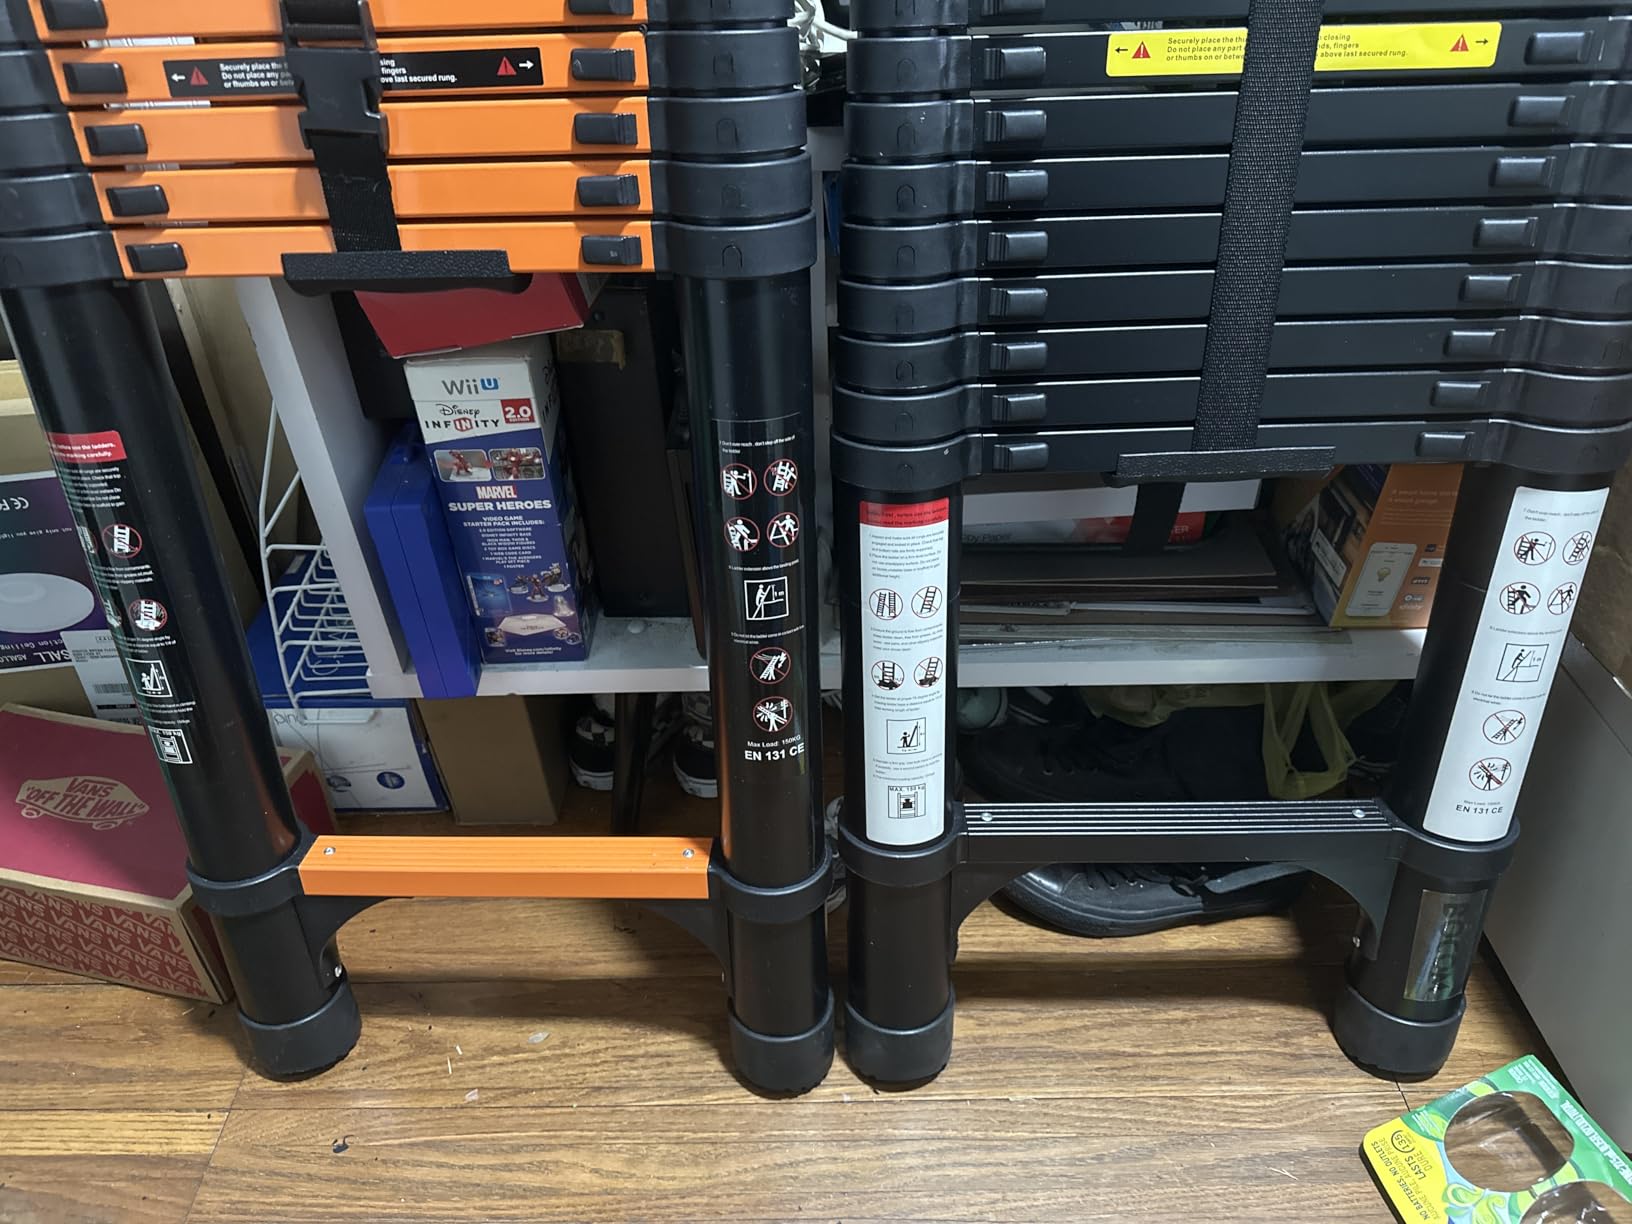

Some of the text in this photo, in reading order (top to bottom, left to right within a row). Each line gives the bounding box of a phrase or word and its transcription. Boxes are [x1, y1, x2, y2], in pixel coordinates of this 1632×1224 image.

[1168, 36, 1234, 46] Securely place the
[1324, 34, 1351, 42] closing
[1333, 42, 1359, 50] fingers
[1192, 45, 1212, 53] place
[1212, 45, 1226, 53] any
[1227, 44, 1242, 53] part
[1320, 50, 1342, 58] above
[219, 63, 250, 72] Securely
[251, 63, 271, 72] place
[221, 72, 279, 81] Do not place any
[381, 67, 407, 76] fingers
[394, 75, 408, 83] last
[409, 74, 437, 82] secured
[438, 74, 457, 84] rung.
[442, 378, 498, 396] Wii U
[425, 406, 531, 432] INFINITY 2.0
[476, 485, 517, 499] MARVEL
[10, 497, 29, 510] CE
[448, 500, 552, 512] SUPER HEROES
[745, 743, 804, 761] EN 131 CE
[65, 778, 118, 797] VANS
[54, 793, 92, 817] THE
[1456, 805, 1504, 815] EN 131 CE
[21, 909, 75, 944] VANS
[50, 909, 104, 945] VANS
[79, 909, 132, 945] VANS
[109, 908, 164, 945] VANS
[51, 936, 104, 970] VANS
[79, 936, 132, 971] VANS
[108, 936, 161, 971] VANS
[137, 936, 191, 972] VANS
[1379, 1137, 1394, 1155] PRISE
[1394, 1132, 1411, 1150] 135
[1391, 1155, 1411, 1179] AUCUNE
[1404, 1155, 1427, 1180] LASTS
[1413, 1150, 1433, 1172] DURE
[1370, 1140, 1430, 1220] NO BATTERIES, NO OUTLETS
